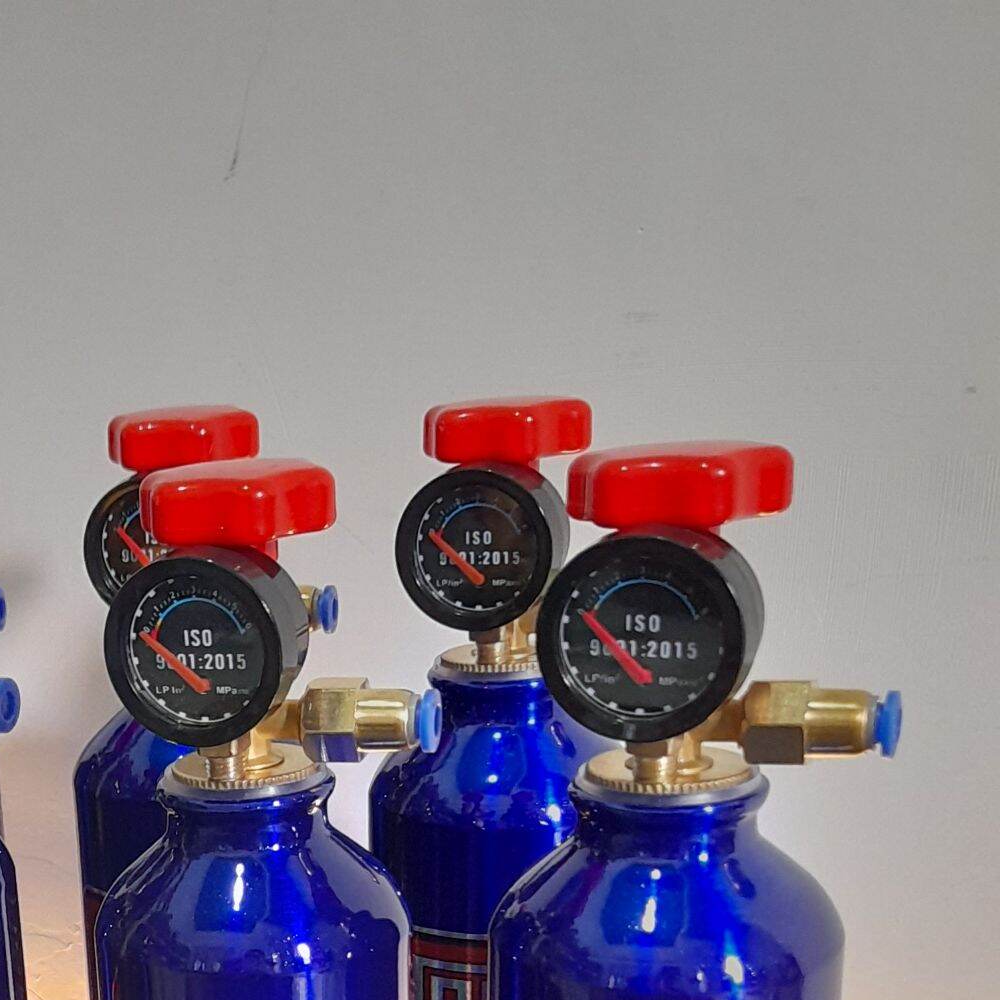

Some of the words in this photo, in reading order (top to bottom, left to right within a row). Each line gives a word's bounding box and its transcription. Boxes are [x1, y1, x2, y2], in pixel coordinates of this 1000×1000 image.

[466, 531, 492, 545] ISO
[625, 614, 661, 632] ISO
[184, 629, 212, 647] ISO
[156, 653, 246, 670] 901:2015
